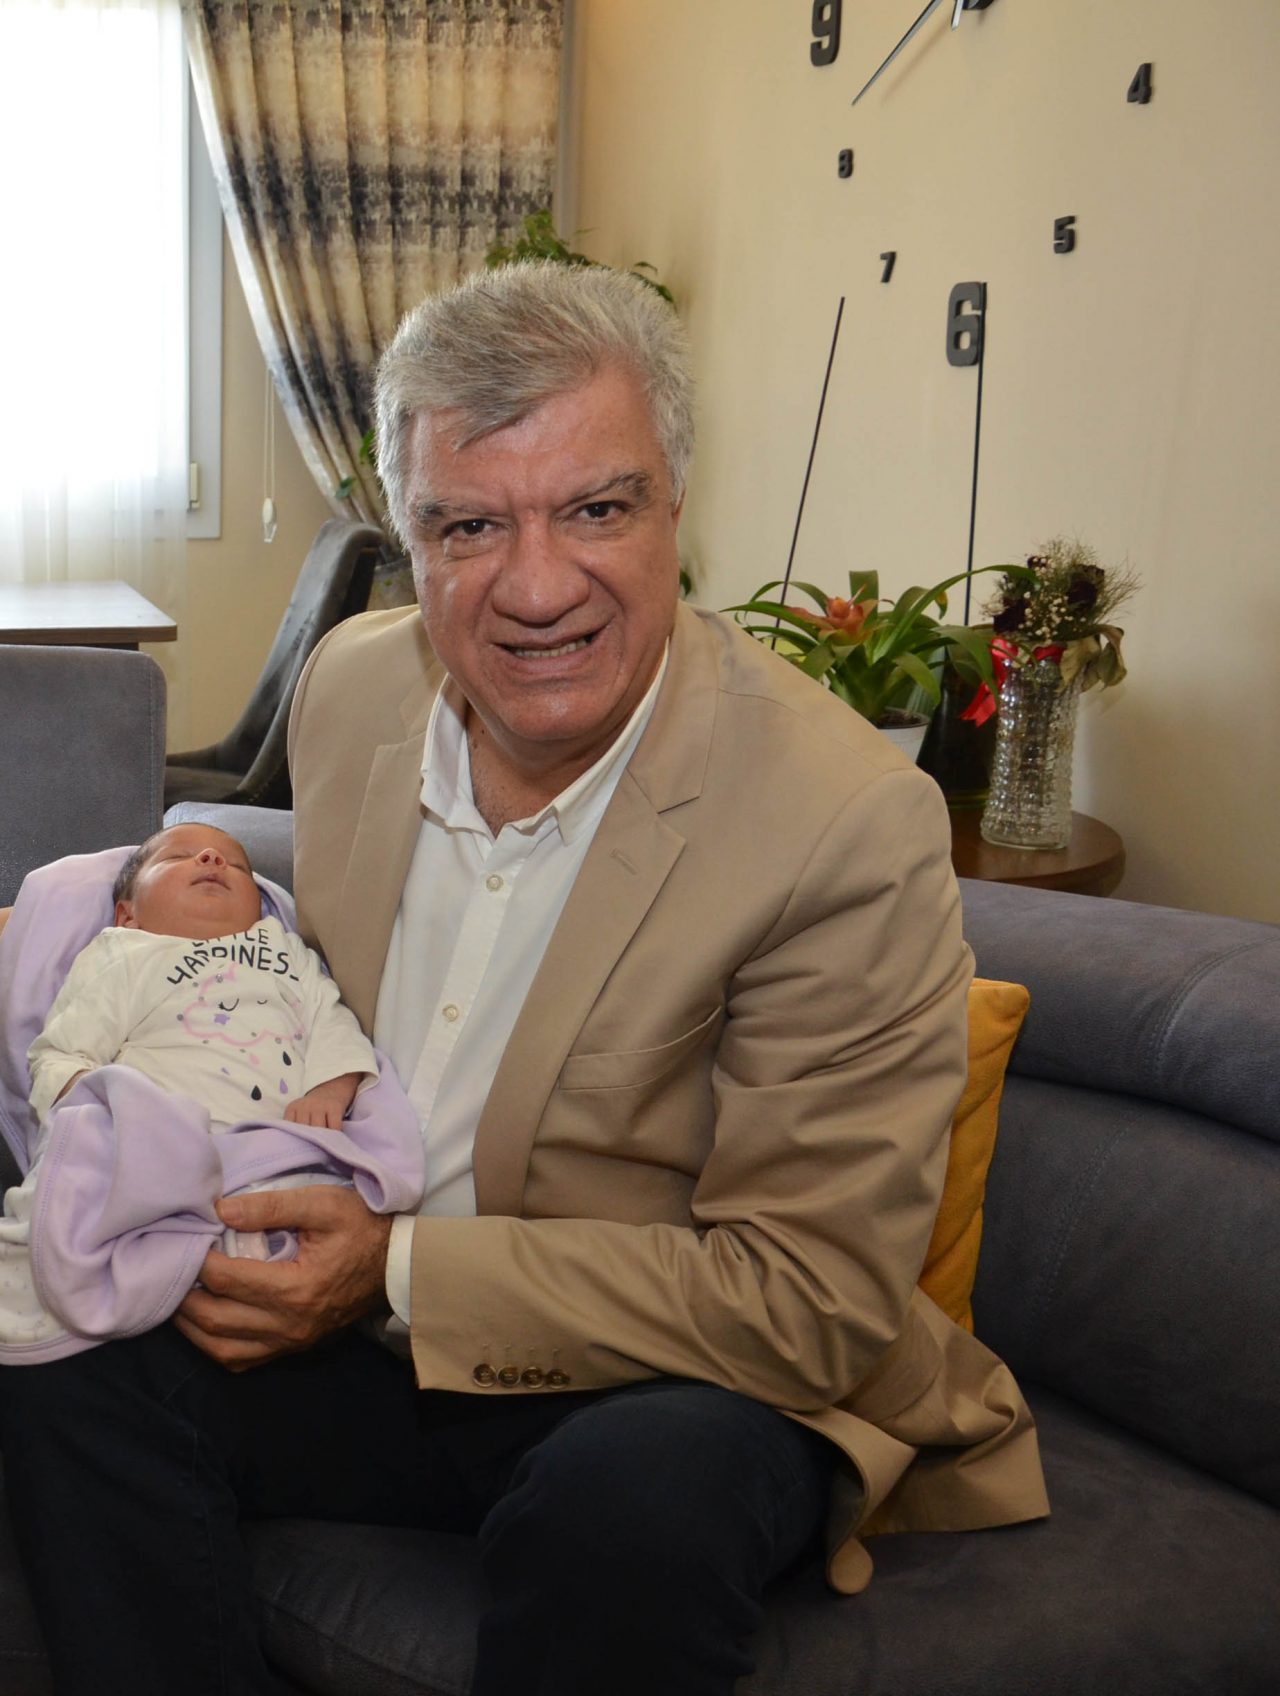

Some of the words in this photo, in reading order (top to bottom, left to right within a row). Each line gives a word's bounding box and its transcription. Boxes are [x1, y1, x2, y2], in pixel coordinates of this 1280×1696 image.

[810, 0, 842, 67] 9
[1127, 62, 1154, 104] 4
[838, 148, 854, 179] 8
[1053, 215, 1076, 254] 5
[880, 251, 897, 283] 7
[946, 281, 984, 367] 6
[167, 944, 299, 984] HAPPINES
